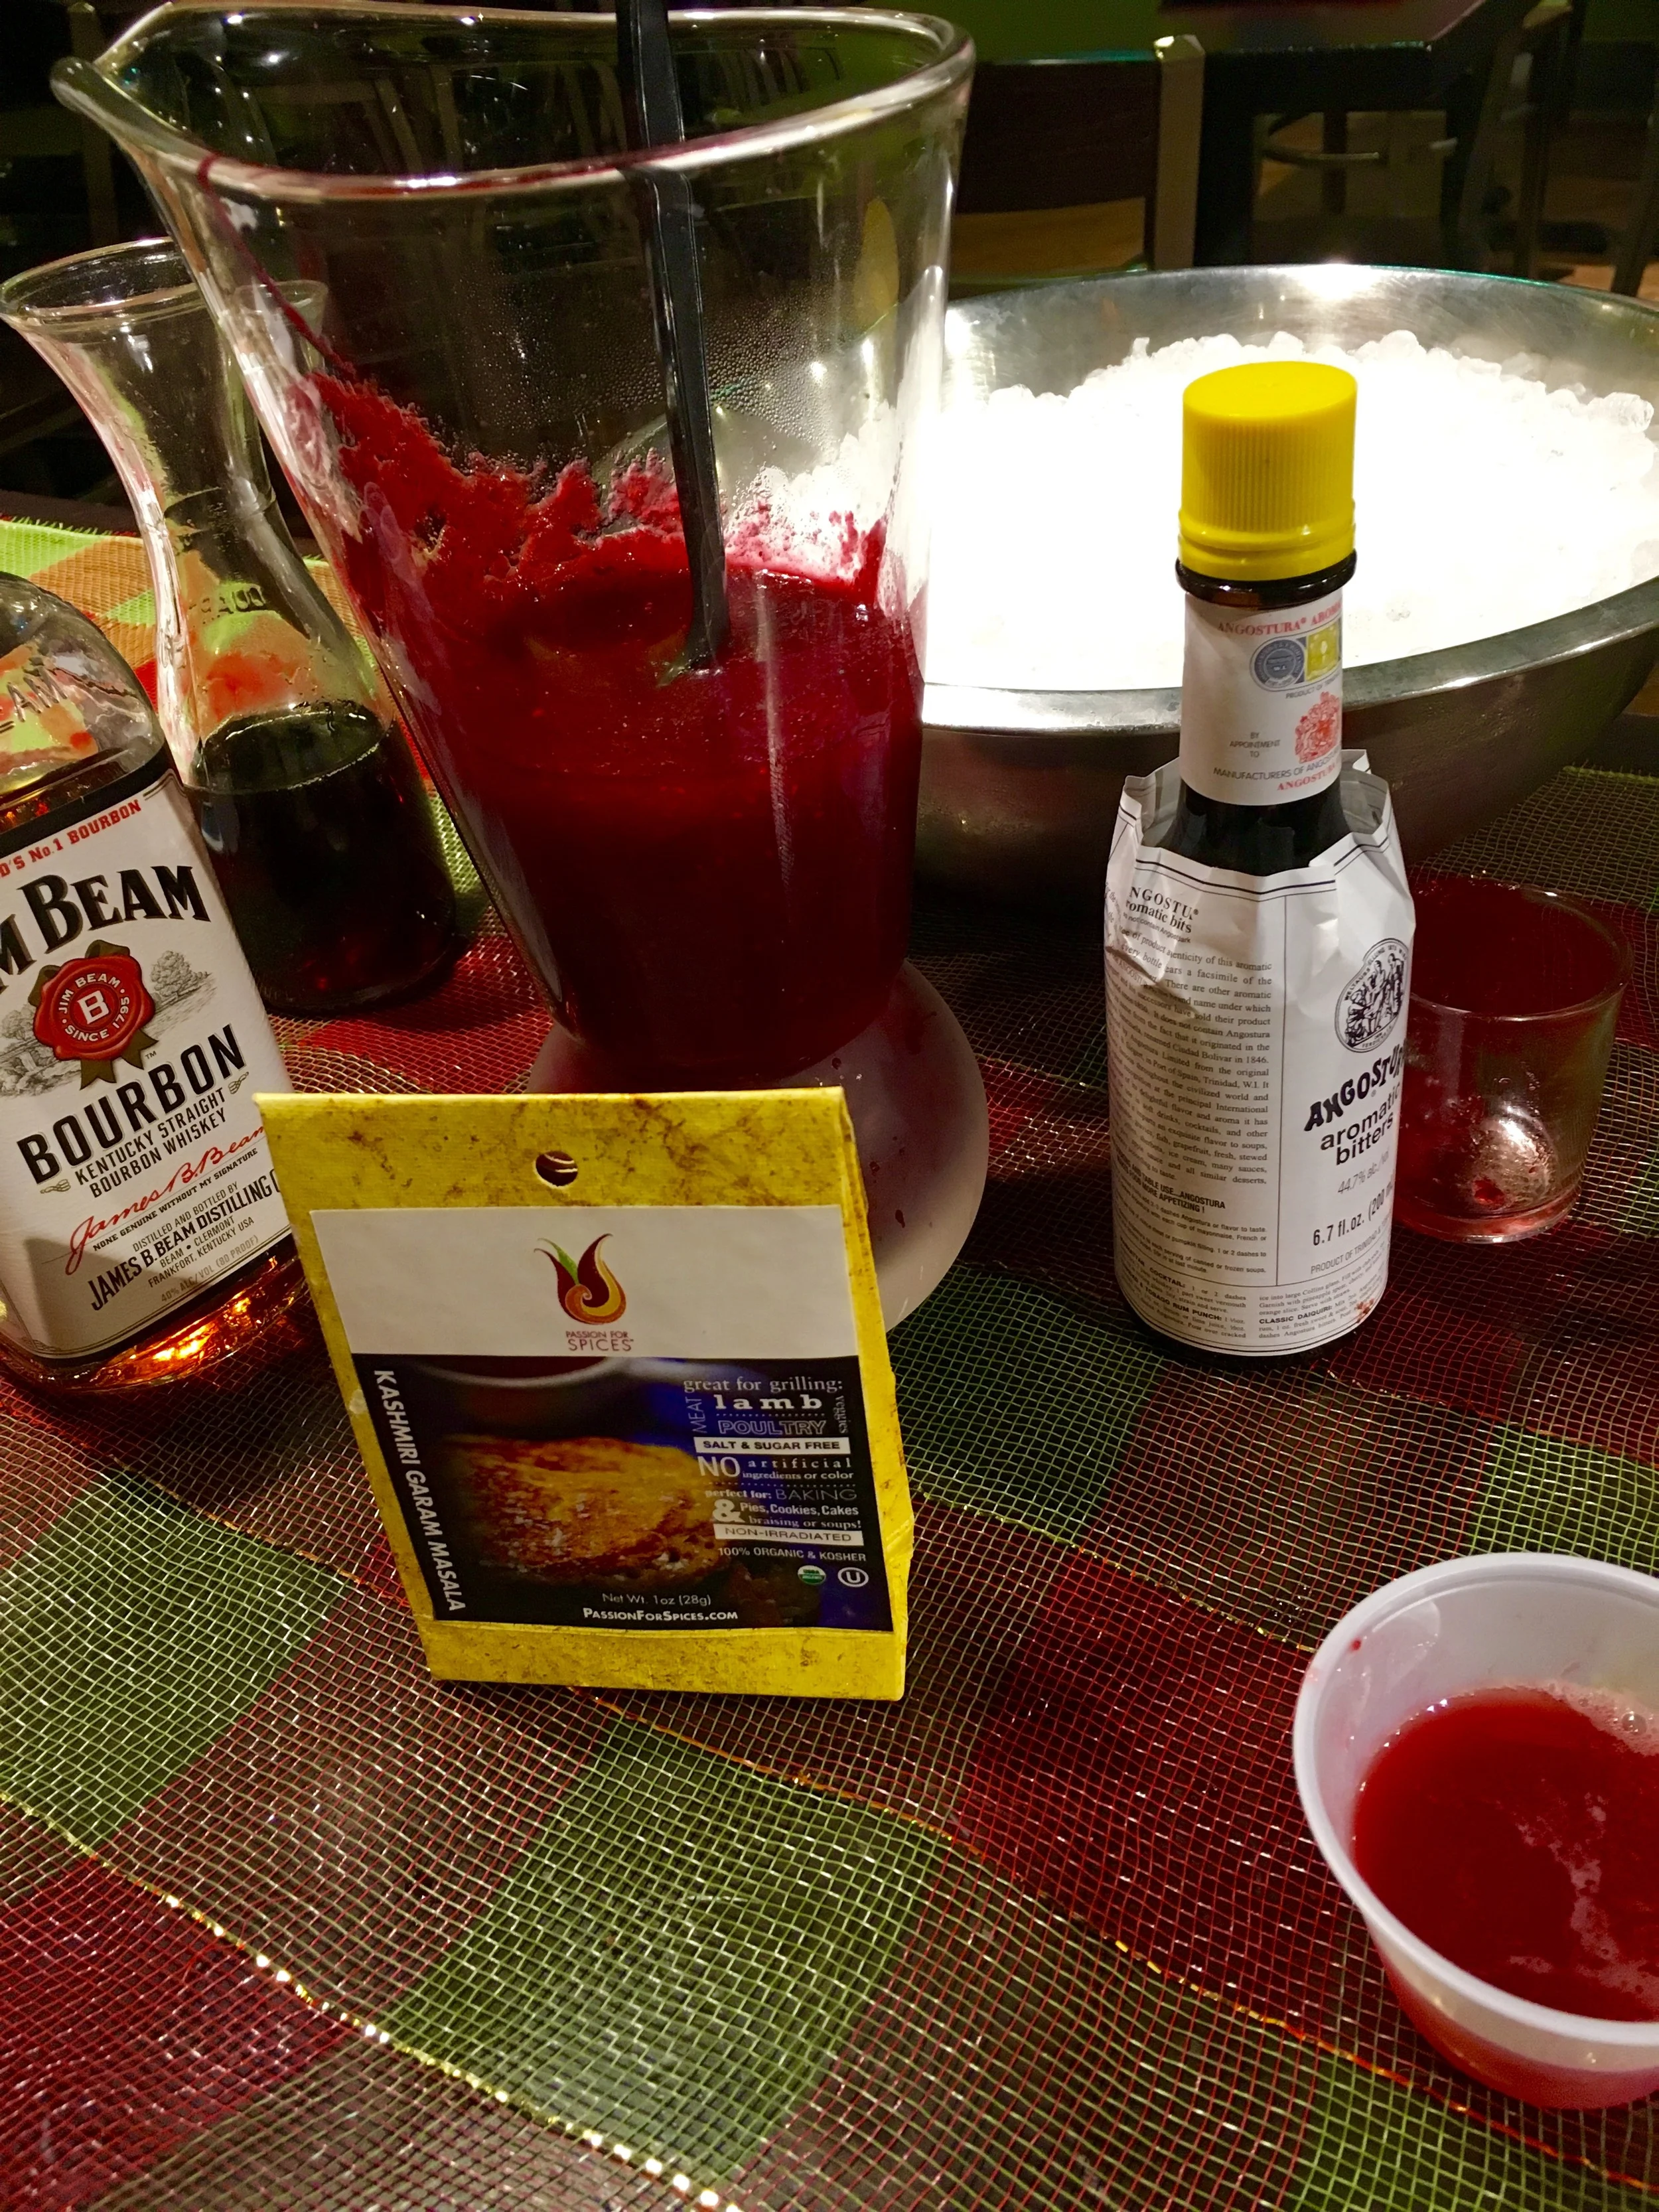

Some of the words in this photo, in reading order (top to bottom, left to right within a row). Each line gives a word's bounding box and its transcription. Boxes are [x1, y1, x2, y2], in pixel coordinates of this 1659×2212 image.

[1230, 740, 1280, 749] APPOINTMENT
[1213, 767, 1292, 780] MANUFACTURERS
[67, 799, 142, 844] BOURBON
[17, 865, 211, 954] BEAM
[1143, 952, 1162, 968] bottle
[1198, 970, 1238, 982] facsimile
[1218, 958, 1236, 967] this
[1236, 961, 1272, 971] aromatic
[59, 990, 74, 1013] JIM
[75, 974, 120, 988] BEAM
[1165, 979, 1188, 990] There
[1209, 987, 1230, 995] other
[77, 990, 109, 1024] B
[1194, 999, 1216, 1008] name
[1218, 1002, 1242, 1011] under
[65, 1025, 109, 1041] SINCE
[112, 997, 129, 1029] 1795
[1194, 1013, 1211, 1021] sold
[1215, 1015, 1234, 1023] their
[1226, 1029, 1270, 1039] Angostura
[1200, 1040, 1242, 1050] originated
[1202, 1051, 1232, 1062] Bolivar
[1194, 1062, 1214, 1072] from
[1236, 1069, 1269, 1077] original
[1203, 1076, 1240, 1088] Trinidad,
[16, 1023, 246, 1185] BOURBON
[1216, 1103, 1268, 1113] International
[75, 1130, 154, 1185] KENTUCKY
[157, 1086, 226, 1139] STRAIGHT
[1204, 1137, 1227, 1146] flavor
[1336, 1112, 1394, 1165] bitters
[90, 1147, 162, 1198] BOURBON
[163, 1107, 226, 1155] WHISKEY
[1214, 1150, 1236, 1160] fresh,
[1212, 1162, 1233, 1172] many
[1200, 1171, 1226, 1181] similar
[93, 1235, 119, 1252] NONE
[120, 1211, 158, 1236] GENUINE
[159, 1186, 198, 1213] WITHOUT
[200, 1178, 212, 1189] MY
[214, 1147, 258, 1179] SIGNATURE
[132, 1222, 173, 1252] DISTILLED
[175, 1212, 192, 1228] AND
[193, 1190, 227, 1215] BOTTLED
[229, 1181, 239, 1195] BY
[159, 1248, 184, 1268] BEAM
[193, 1217, 236, 1246] CLERMONT
[1313, 1224, 1334, 1246] 6.7
[88, 1256, 142, 1311] JAMES
[196, 1175, 272, 1228] DISTILLING
[148, 1254, 197, 1288] FRANKFORT,
[197, 1228, 237, 1258] KENTUCKY
[239, 1217, 254, 1232] USA
[161, 1286, 180, 1303] 40%
[180, 1266, 215, 1291] ALC/VOL
[216, 1255, 230, 1268] (80
[230, 1235, 259, 1259] PROOF)
[1311, 1254, 1343, 1274] PRODUCT
[1303, 1286, 1324, 1295] Collins
[684, 1378, 730, 1392] great
[737, 1376, 762, 1391] for
[770, 1376, 843, 1393] grilling:
[713, 1394, 823, 1410] lamb
[685, 1396, 708, 1434] MEAT
[833, 1395, 851, 1434] veggies
[718, 1420, 827, 1435] POULTRY
[703, 1441, 737, 1449] SALT
[754, 1441, 801, 1450] SUGAR
[805, 1441, 841, 1450] FREE
[697, 1455, 741, 1478] NO
[747, 1457, 852, 1469] artificial
[743, 1471, 801, 1481] ingredients
[820, 1471, 854, 1480] color
[374, 1369, 421, 1465] KASHMIRI
[405, 1470, 443, 1536] GARAM
[427, 1540, 466, 1611] MASALA
[705, 1489, 748, 1499] perfect
[750, 1489, 772, 1500] for:
[775, 1489, 857, 1501] BAKING
[712, 1499, 745, 1523] &
[822, 1505, 859, 1516] Cakes
[749, 1515, 799, 1528] braising
[820, 1520, 862, 1530] soups!
[725, 1528, 852, 1542] NON-IRRADIATED
[718, 1547, 751, 1556] 100%
[753, 1548, 804, 1558] ORGANIC
[807, 1550, 816, 1560] &
[820, 1552, 867, 1562] KOSHER
[602, 1593, 624, 1603] Net
[626, 1593, 649, 1605] Wt.
[679, 1594, 711, 1607] (28g)
